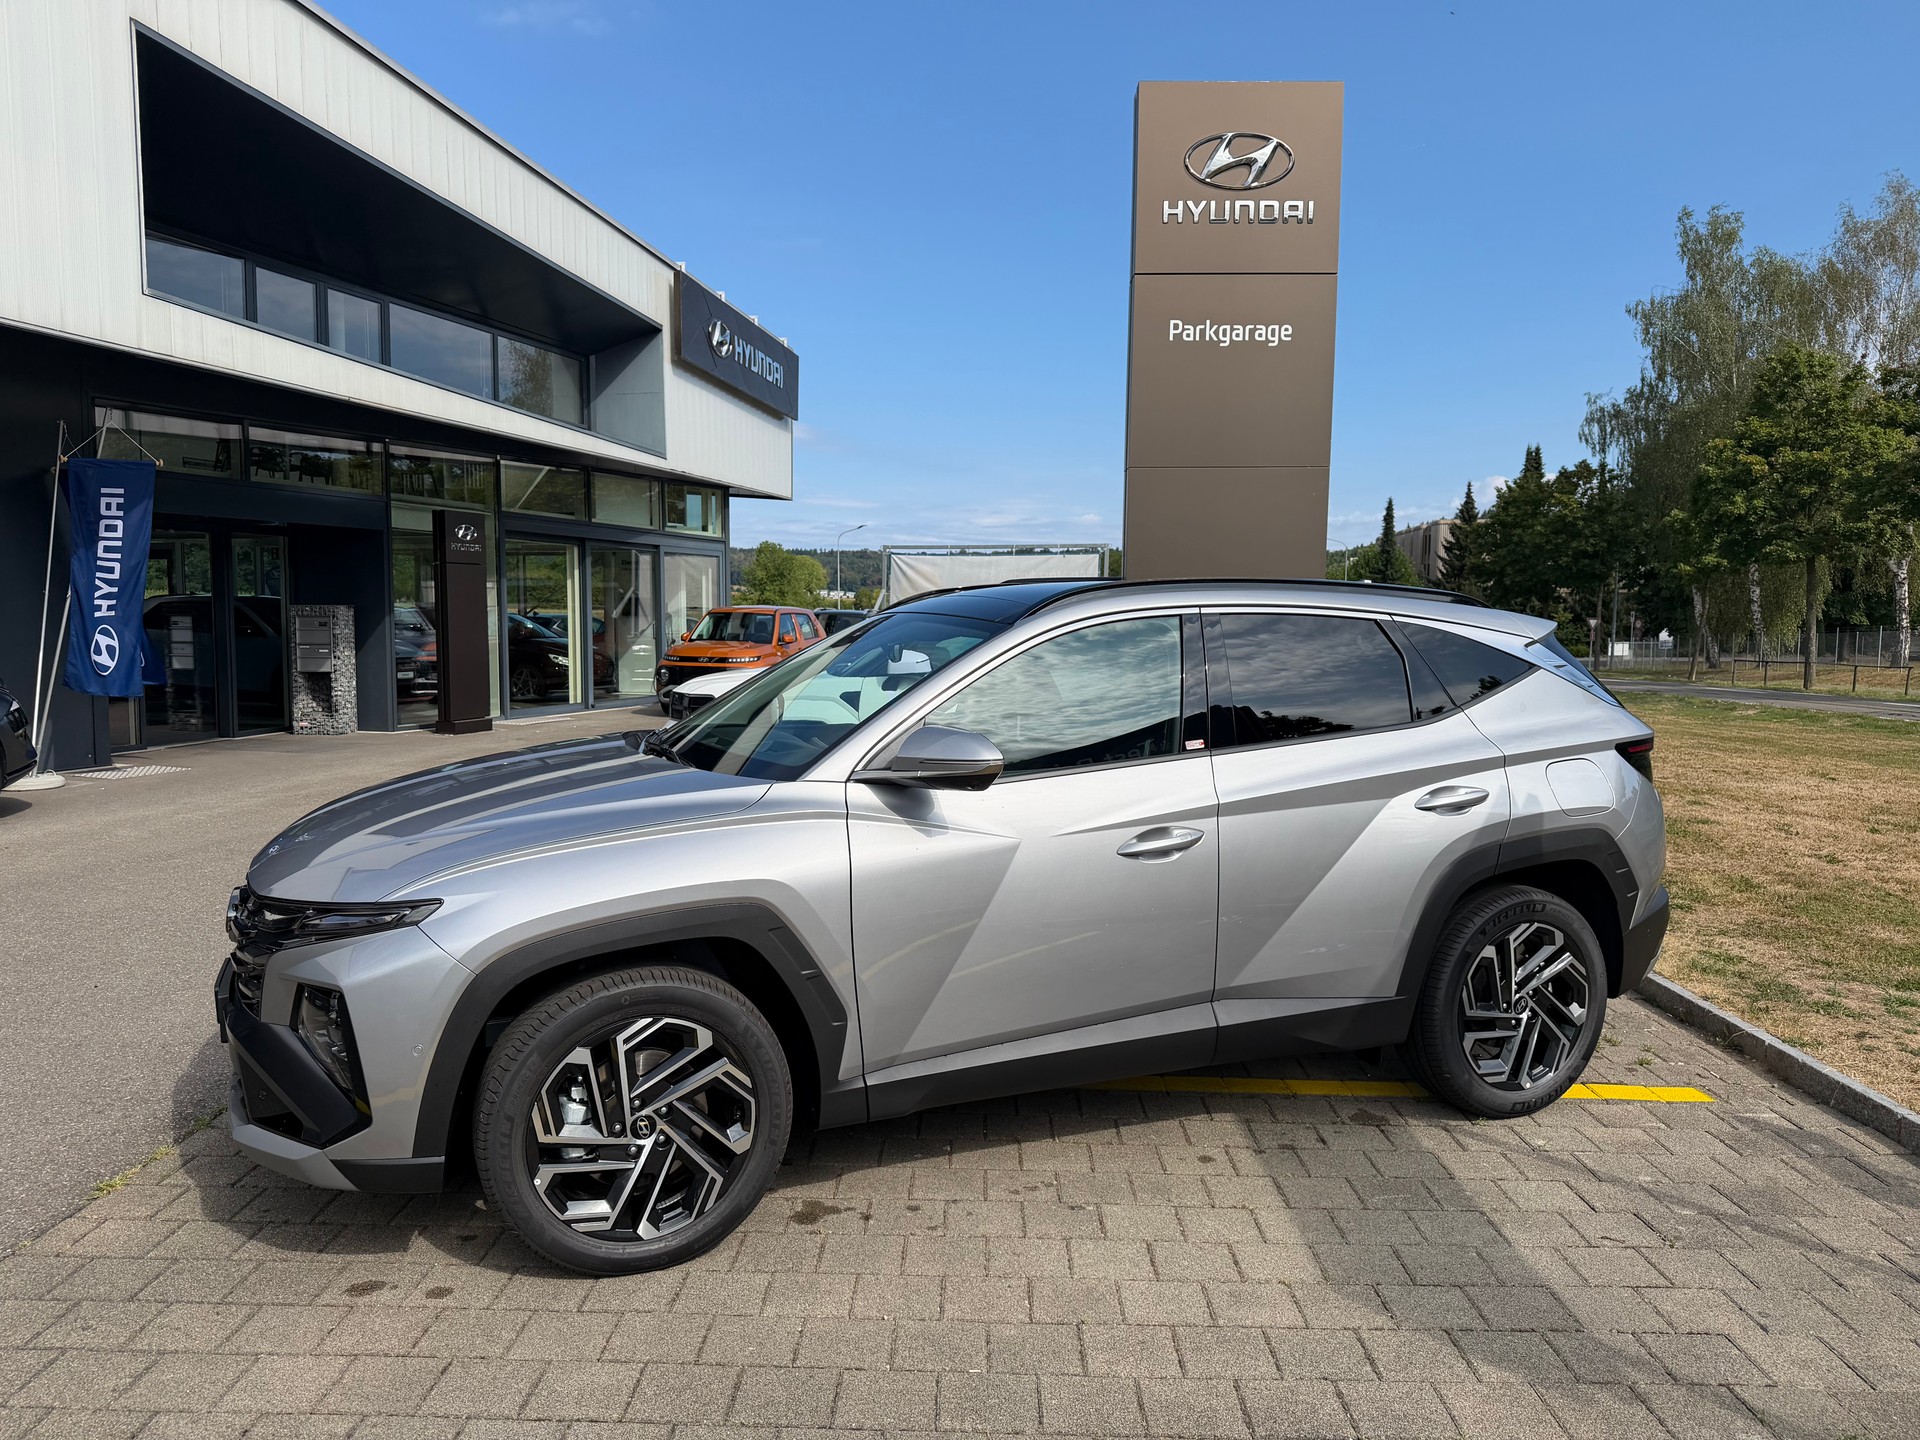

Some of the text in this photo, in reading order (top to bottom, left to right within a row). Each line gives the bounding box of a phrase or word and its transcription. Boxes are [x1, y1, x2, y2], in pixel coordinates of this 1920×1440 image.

[1162, 200, 1315, 225] HYUNDAI
[1169, 319, 1293, 347] Parkgarage
[734, 335, 784, 388] HYUNDAI
[94, 487, 125, 618] HYUNDAI
[450, 543, 482, 552] HYUNDAI
[1484, 903, 1546, 932] MICHELIN
